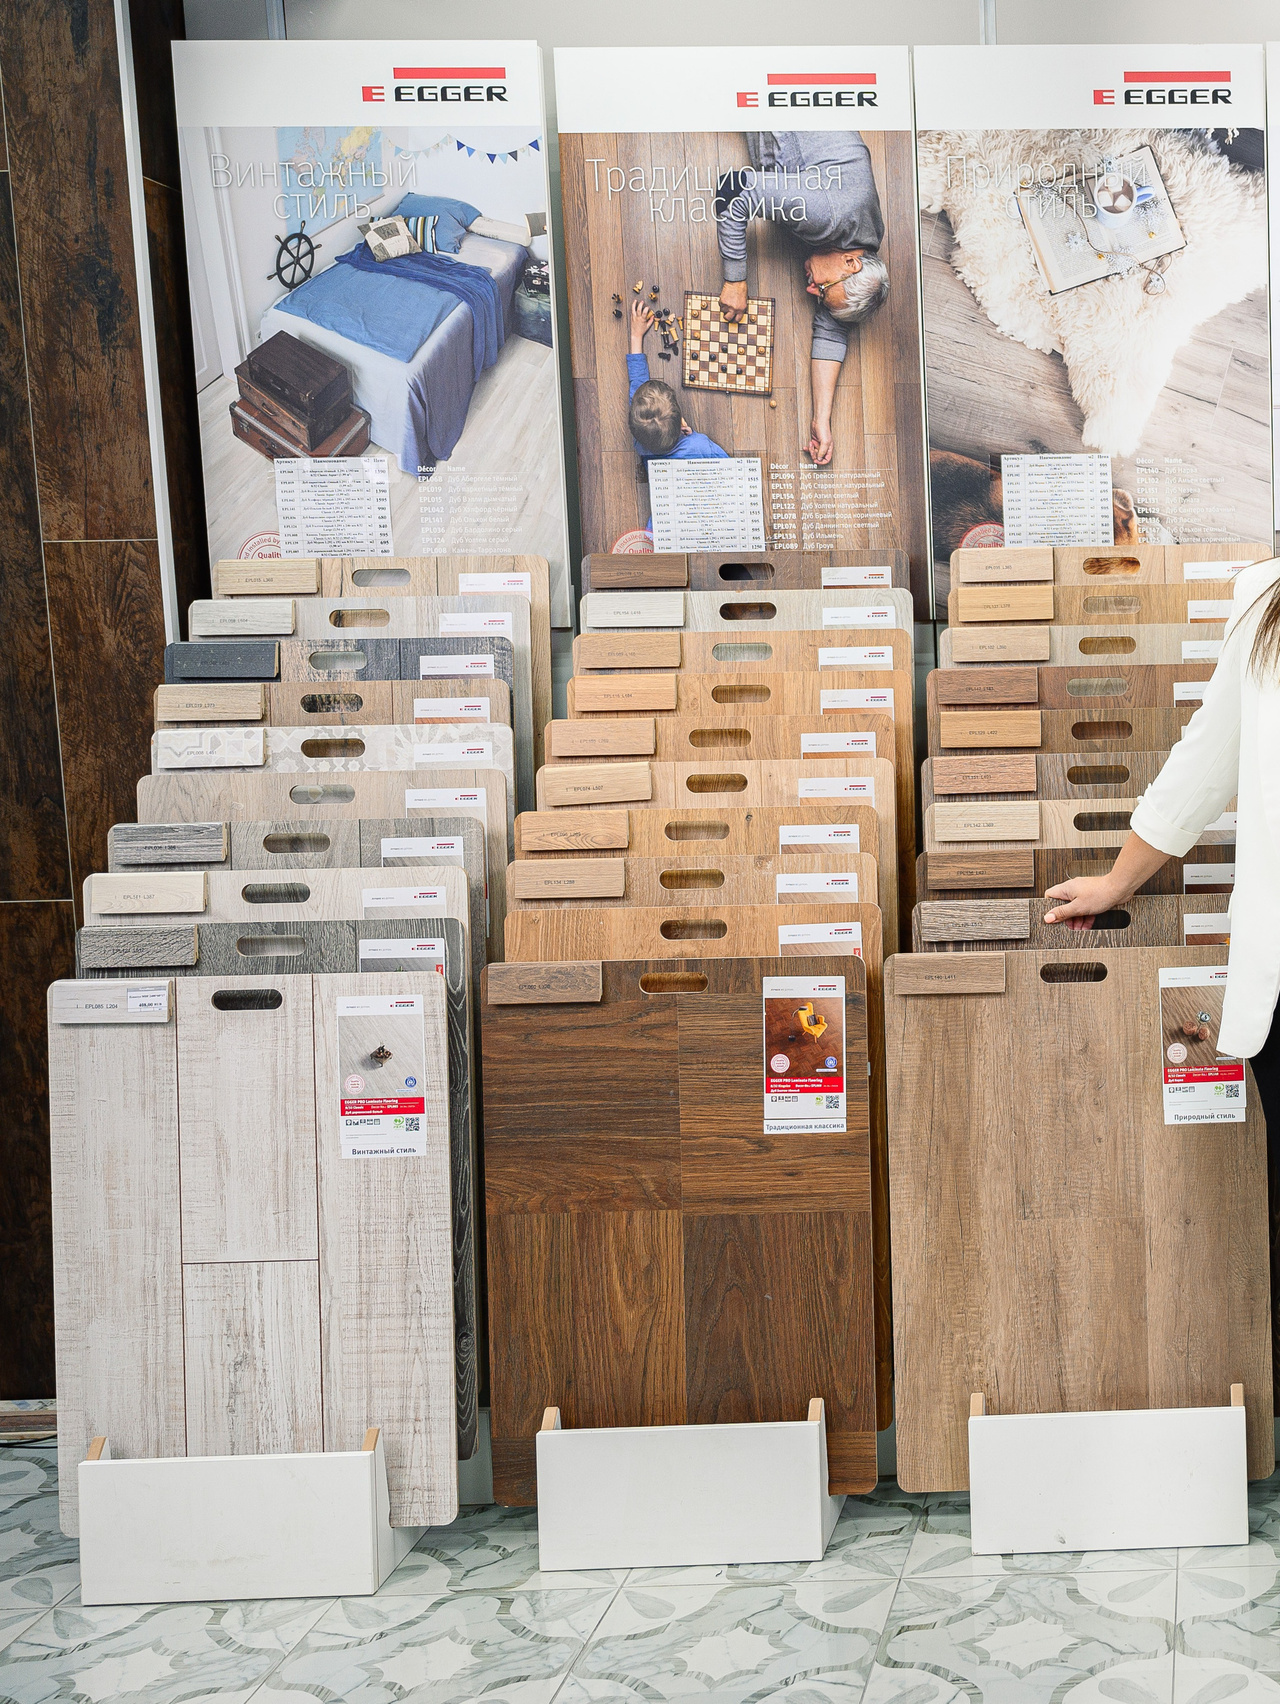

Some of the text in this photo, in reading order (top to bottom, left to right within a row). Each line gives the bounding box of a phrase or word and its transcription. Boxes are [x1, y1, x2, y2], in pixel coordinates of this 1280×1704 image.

[394, 85, 509, 102] EGGER
[767, 90, 879, 107] EGGER
[1124, 88, 1231, 105] EGGER
[210, 151, 418, 189] Винтажный
[585, 157, 844, 197] Традиционная
[946, 153, 1150, 195] Природный
[272, 189, 371, 220] стиль
[649, 190, 808, 223] классика
[1005, 189, 1096, 219] стиль
[837, 502, 878, 510] натуральный
[1174, 1112, 1215, 1121] Природный
[766, 1123, 813, 1131] Традиционная
[352, 1146, 395, 1155] Винтажный
